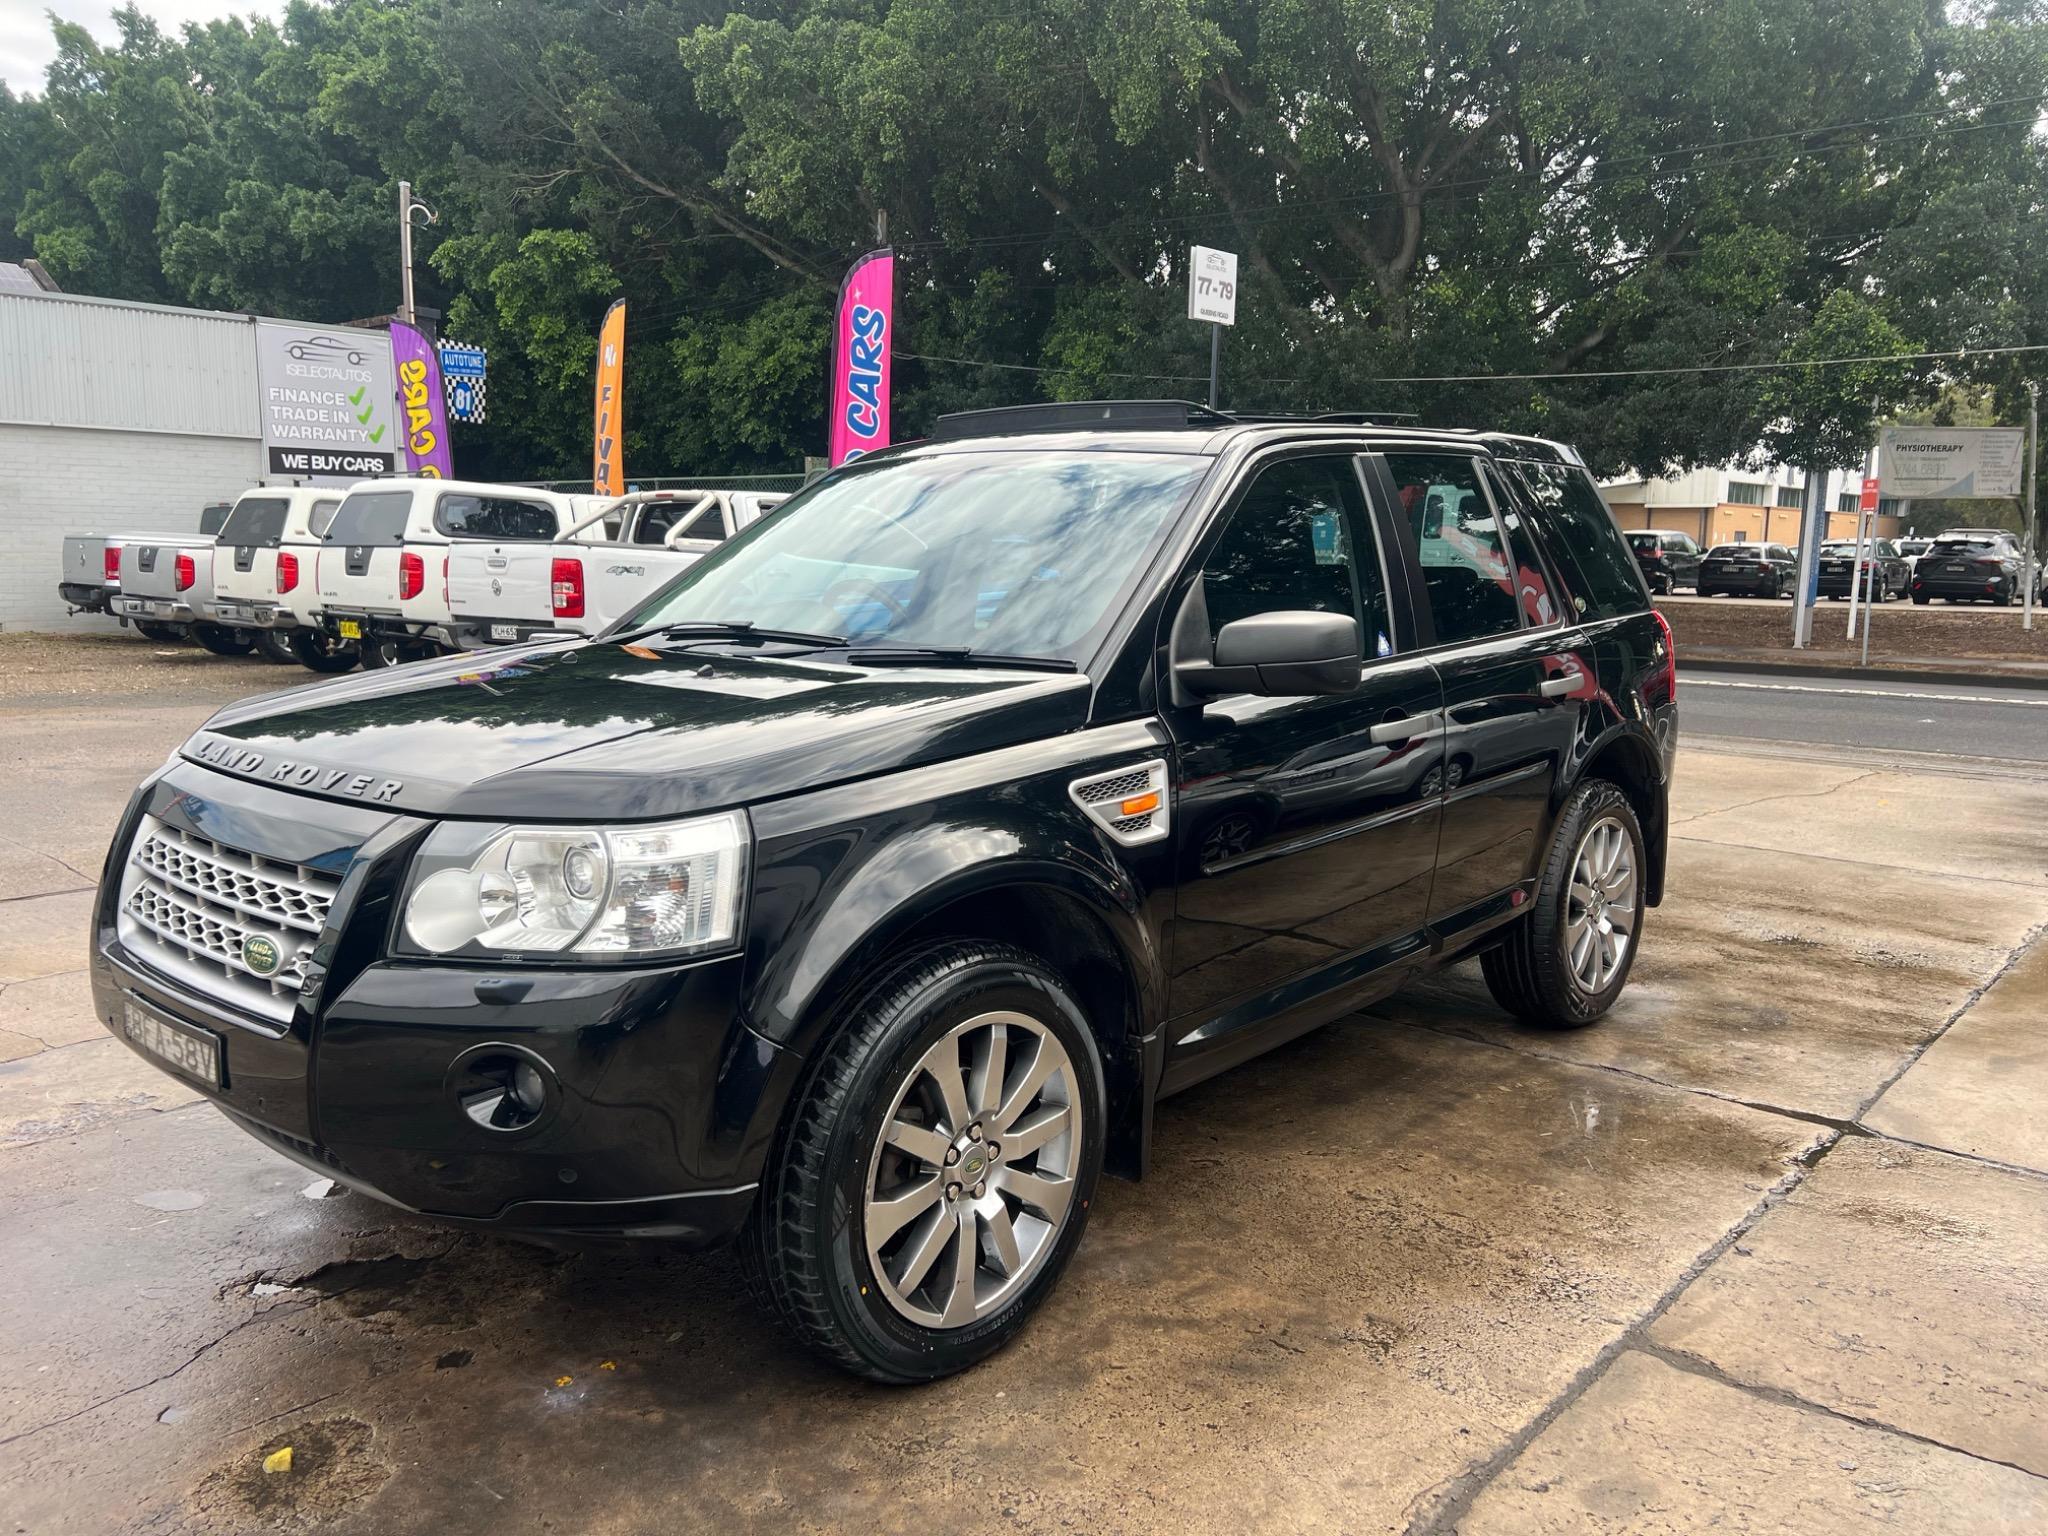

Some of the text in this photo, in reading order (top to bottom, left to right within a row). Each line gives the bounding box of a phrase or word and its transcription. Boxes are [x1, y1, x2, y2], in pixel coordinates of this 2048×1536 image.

[444, 353, 483, 367] AUTOTUNE
[285, 363, 373, 383] ISELECTAUTOS
[846, 304, 887, 439] CARS
[269, 387, 345, 405] FINANCE
[455, 388, 471, 411] 81
[270, 405, 350, 423] TRADE IN
[272, 424, 369, 443] WARRANTY
[1895, 444, 1964, 452] PHYSIOTHERAPY
[281, 453, 384, 473] WE BUY CARS
[197, 740, 404, 803] LAND ROVER
